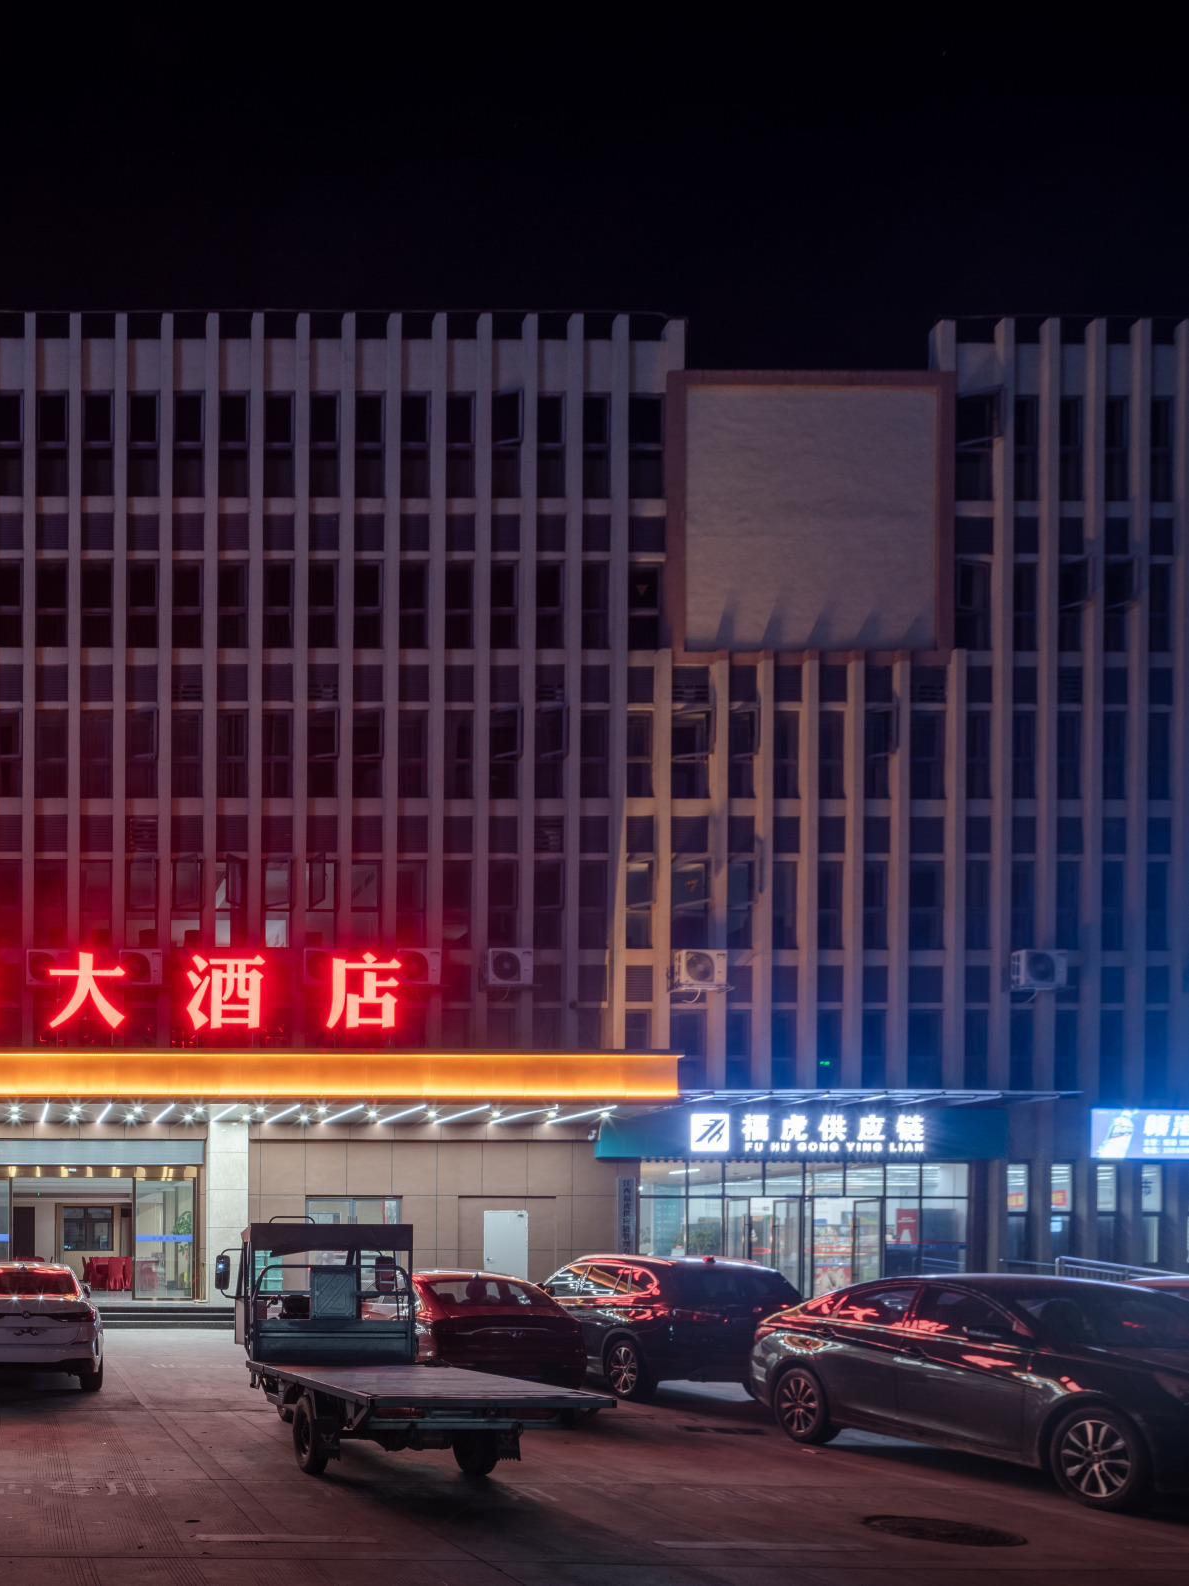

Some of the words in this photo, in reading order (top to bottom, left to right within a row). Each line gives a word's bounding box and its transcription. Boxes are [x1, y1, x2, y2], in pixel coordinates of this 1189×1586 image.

[741, 1114, 925, 1141] 福虎供应链
[744, 1142, 763, 1152] FU
[770, 1142, 790, 1152] HU
[797, 1142, 840, 1152] GONG
[846, 1142, 883, 1152] YING
[889, 1142, 924, 1152] LIAN
